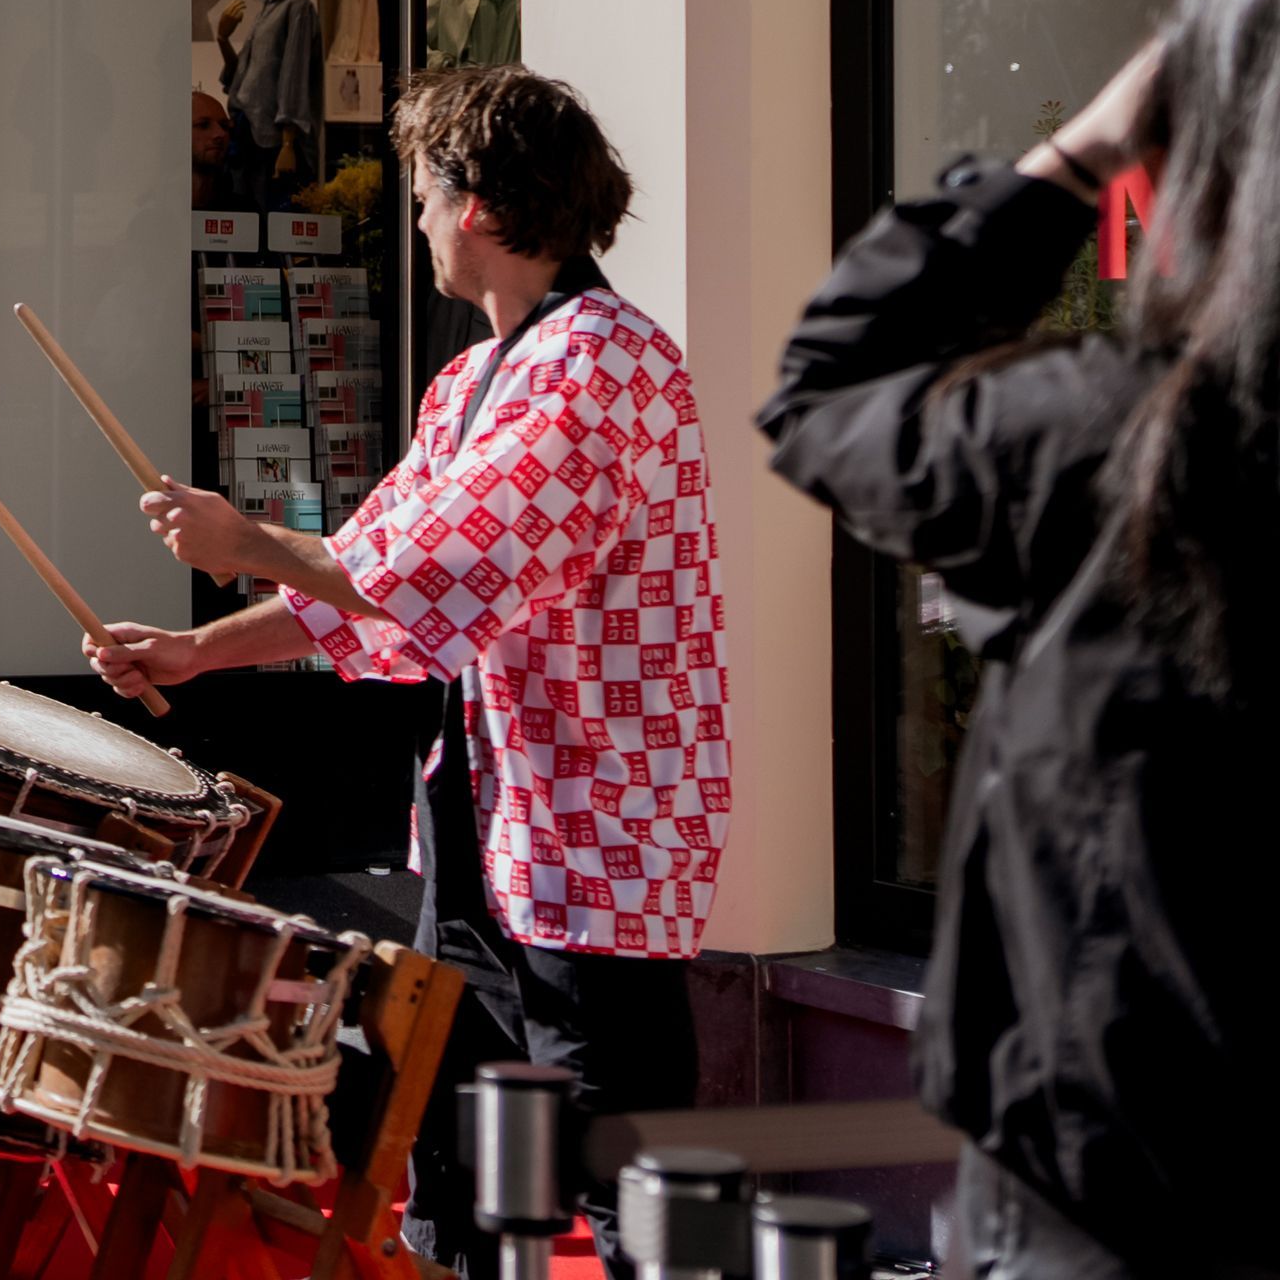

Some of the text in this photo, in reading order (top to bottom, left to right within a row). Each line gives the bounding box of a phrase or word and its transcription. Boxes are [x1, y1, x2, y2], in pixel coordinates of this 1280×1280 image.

[223, 274, 265, 286] LifeWear
[312, 274, 352, 286] LifeWear
[325, 324, 365, 336] LifeWe
[237, 337, 271, 346] LifeWear
[243, 380, 284, 392] LifeWear
[256, 443, 291, 453] LifeWear
[558, 455, 582, 479] UNI
[571, 464, 594, 490] QLO
[465, 562, 491, 586] UNI
[477, 571, 503, 597] QLO
[641, 575, 666, 588] UNI
[642, 590, 670, 602] QLO
[414, 610, 440, 635] UNI
[324, 631, 348, 649] UNI
[425, 622, 451, 649] QLO
[332, 640, 357, 657] QLO
[643, 648, 670, 660] UNI
[644, 663, 673, 675] QLO
[647, 719, 673, 730] UNI
[647, 733, 676, 746] QLO
[606, 851, 633, 862] UNI
[609, 865, 639, 877] QLO
[618, 919, 643, 930] UNI
[618, 933, 644, 945] QLO
